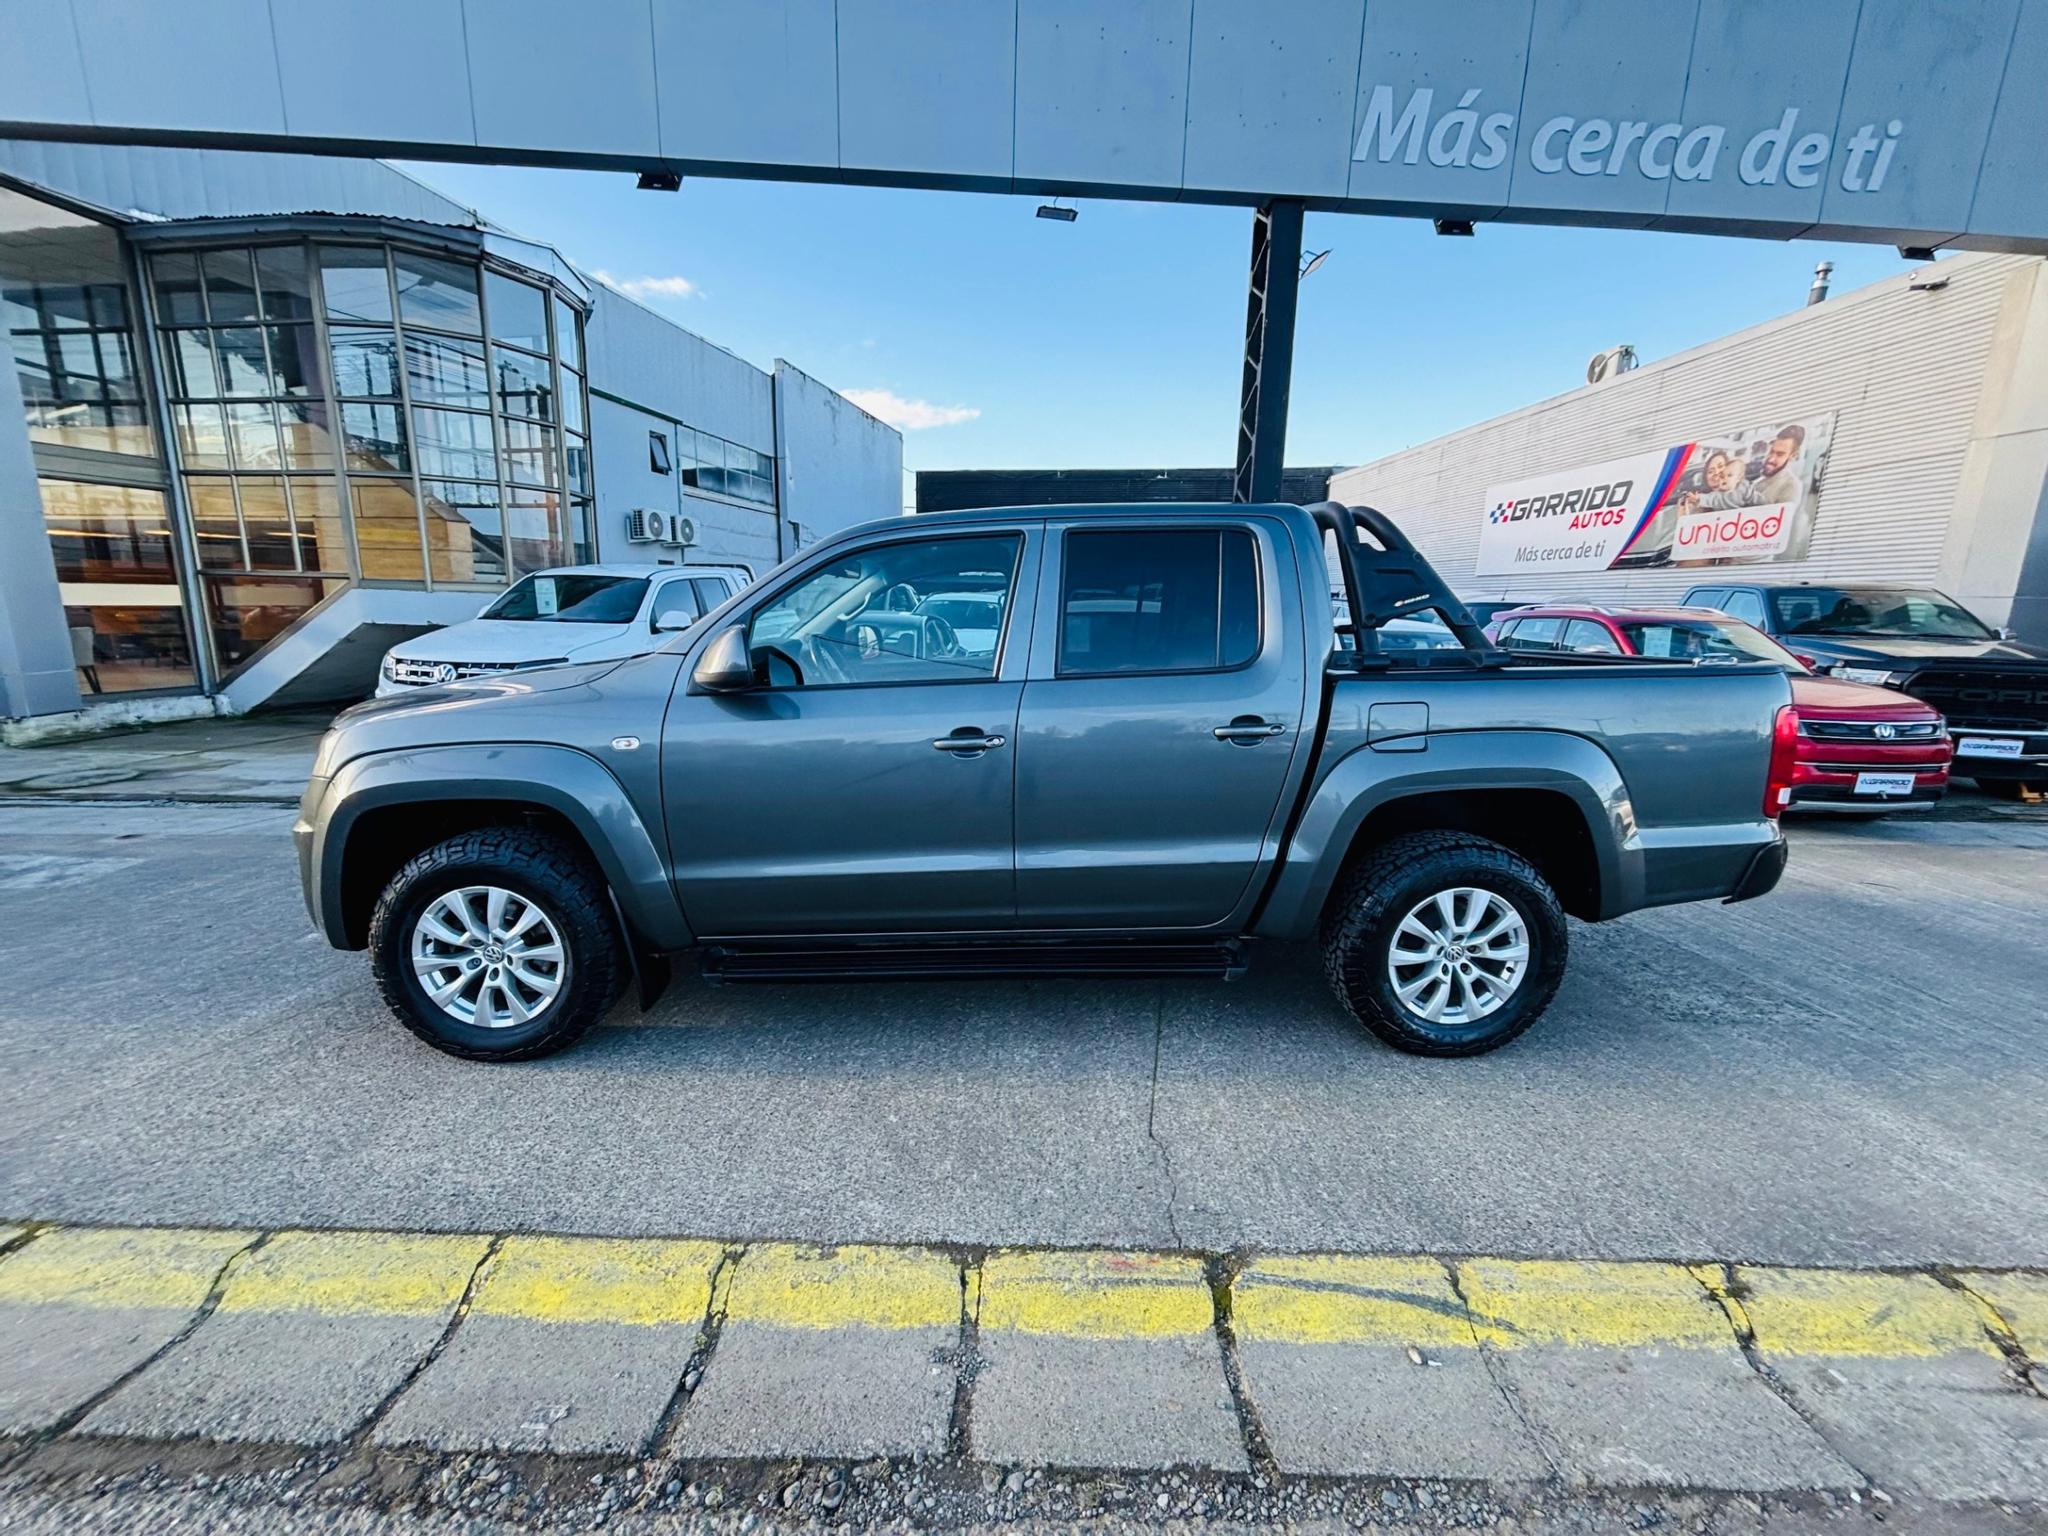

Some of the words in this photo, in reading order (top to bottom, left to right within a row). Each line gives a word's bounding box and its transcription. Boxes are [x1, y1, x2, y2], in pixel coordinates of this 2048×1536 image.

[1352, 84, 1514, 169] Más
[1531, 116, 1726, 181] cerca
[1740, 108, 1831, 188] de
[1840, 120, 1903, 191] ti
[1510, 480, 1634, 521] GARRIDO
[1569, 508, 1626, 530] AUTOS
[1679, 507, 1784, 545] unidad
[1515, 546, 1538, 562] Más
[1541, 547, 1572, 561] cerca
[1575, 541, 1591, 558] de
[1595, 540, 1606, 557] ti
